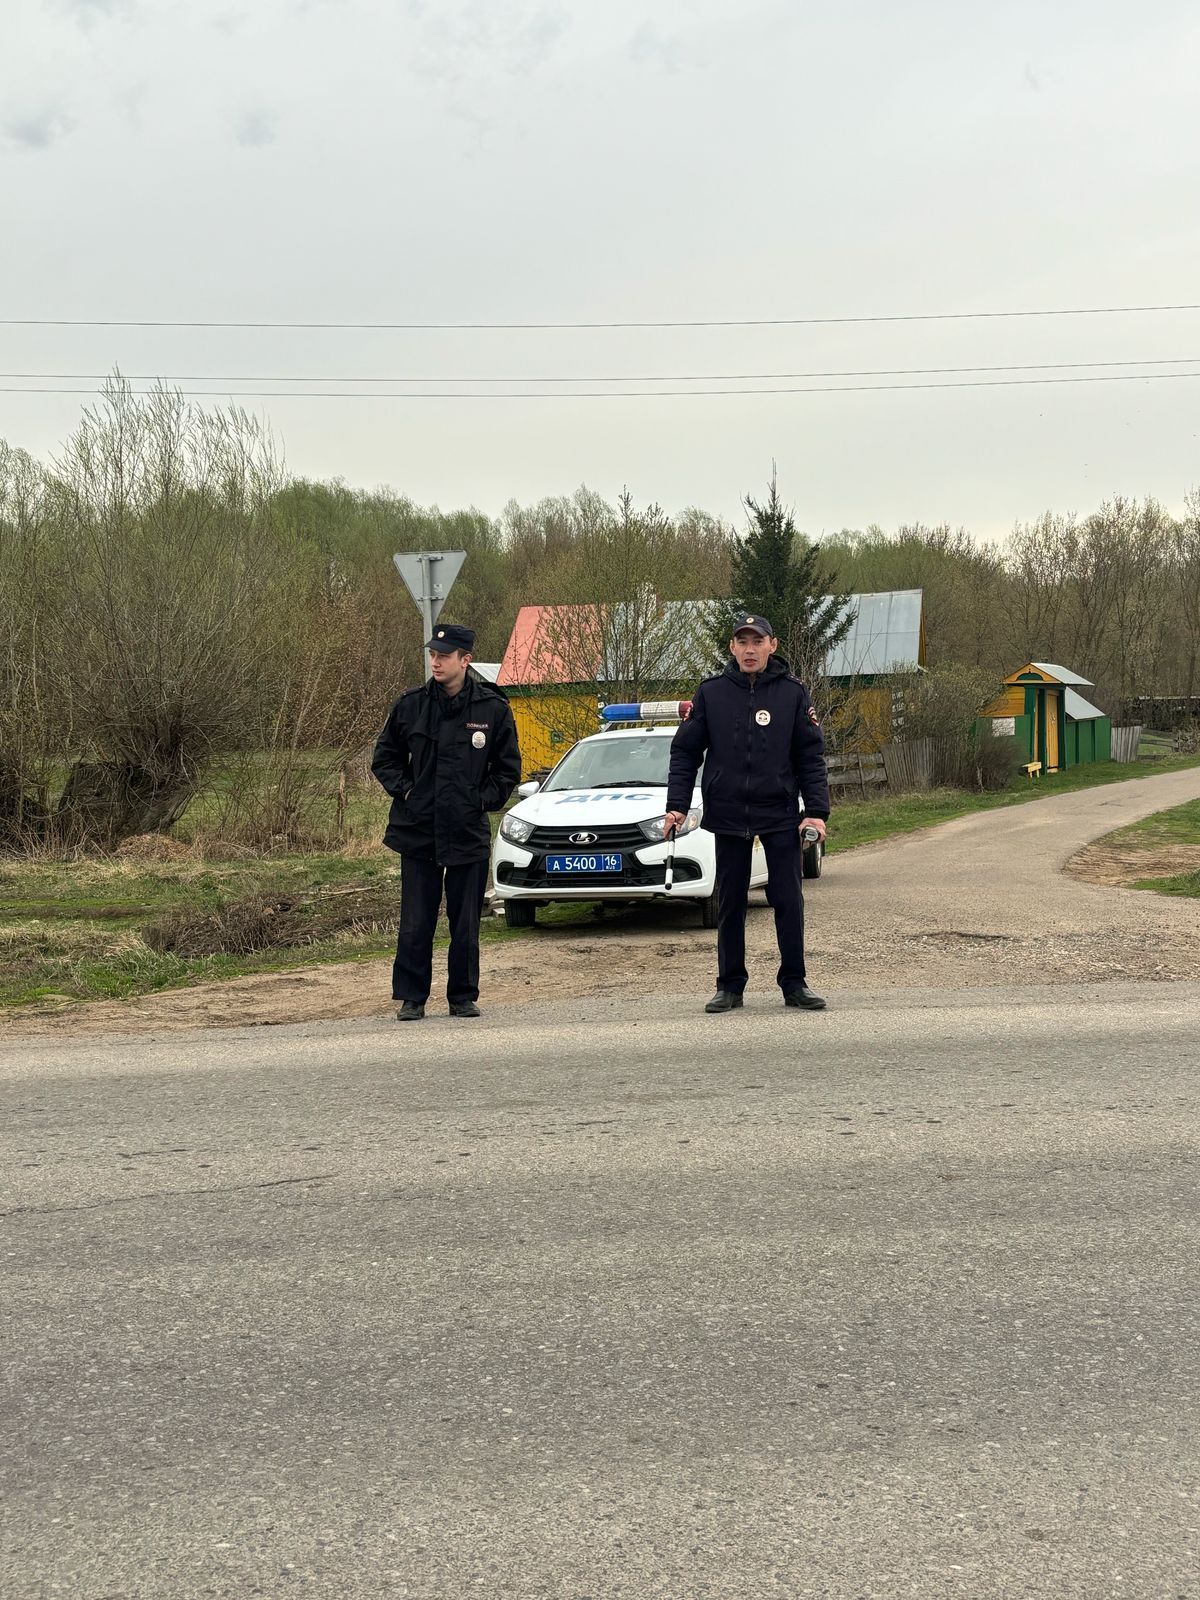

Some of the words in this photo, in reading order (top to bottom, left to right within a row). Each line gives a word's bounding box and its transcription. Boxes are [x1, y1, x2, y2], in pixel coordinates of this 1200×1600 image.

[555, 793, 654, 805] ДПС
[566, 857, 596, 869] 5400
[605, 856, 616, 865] 16
